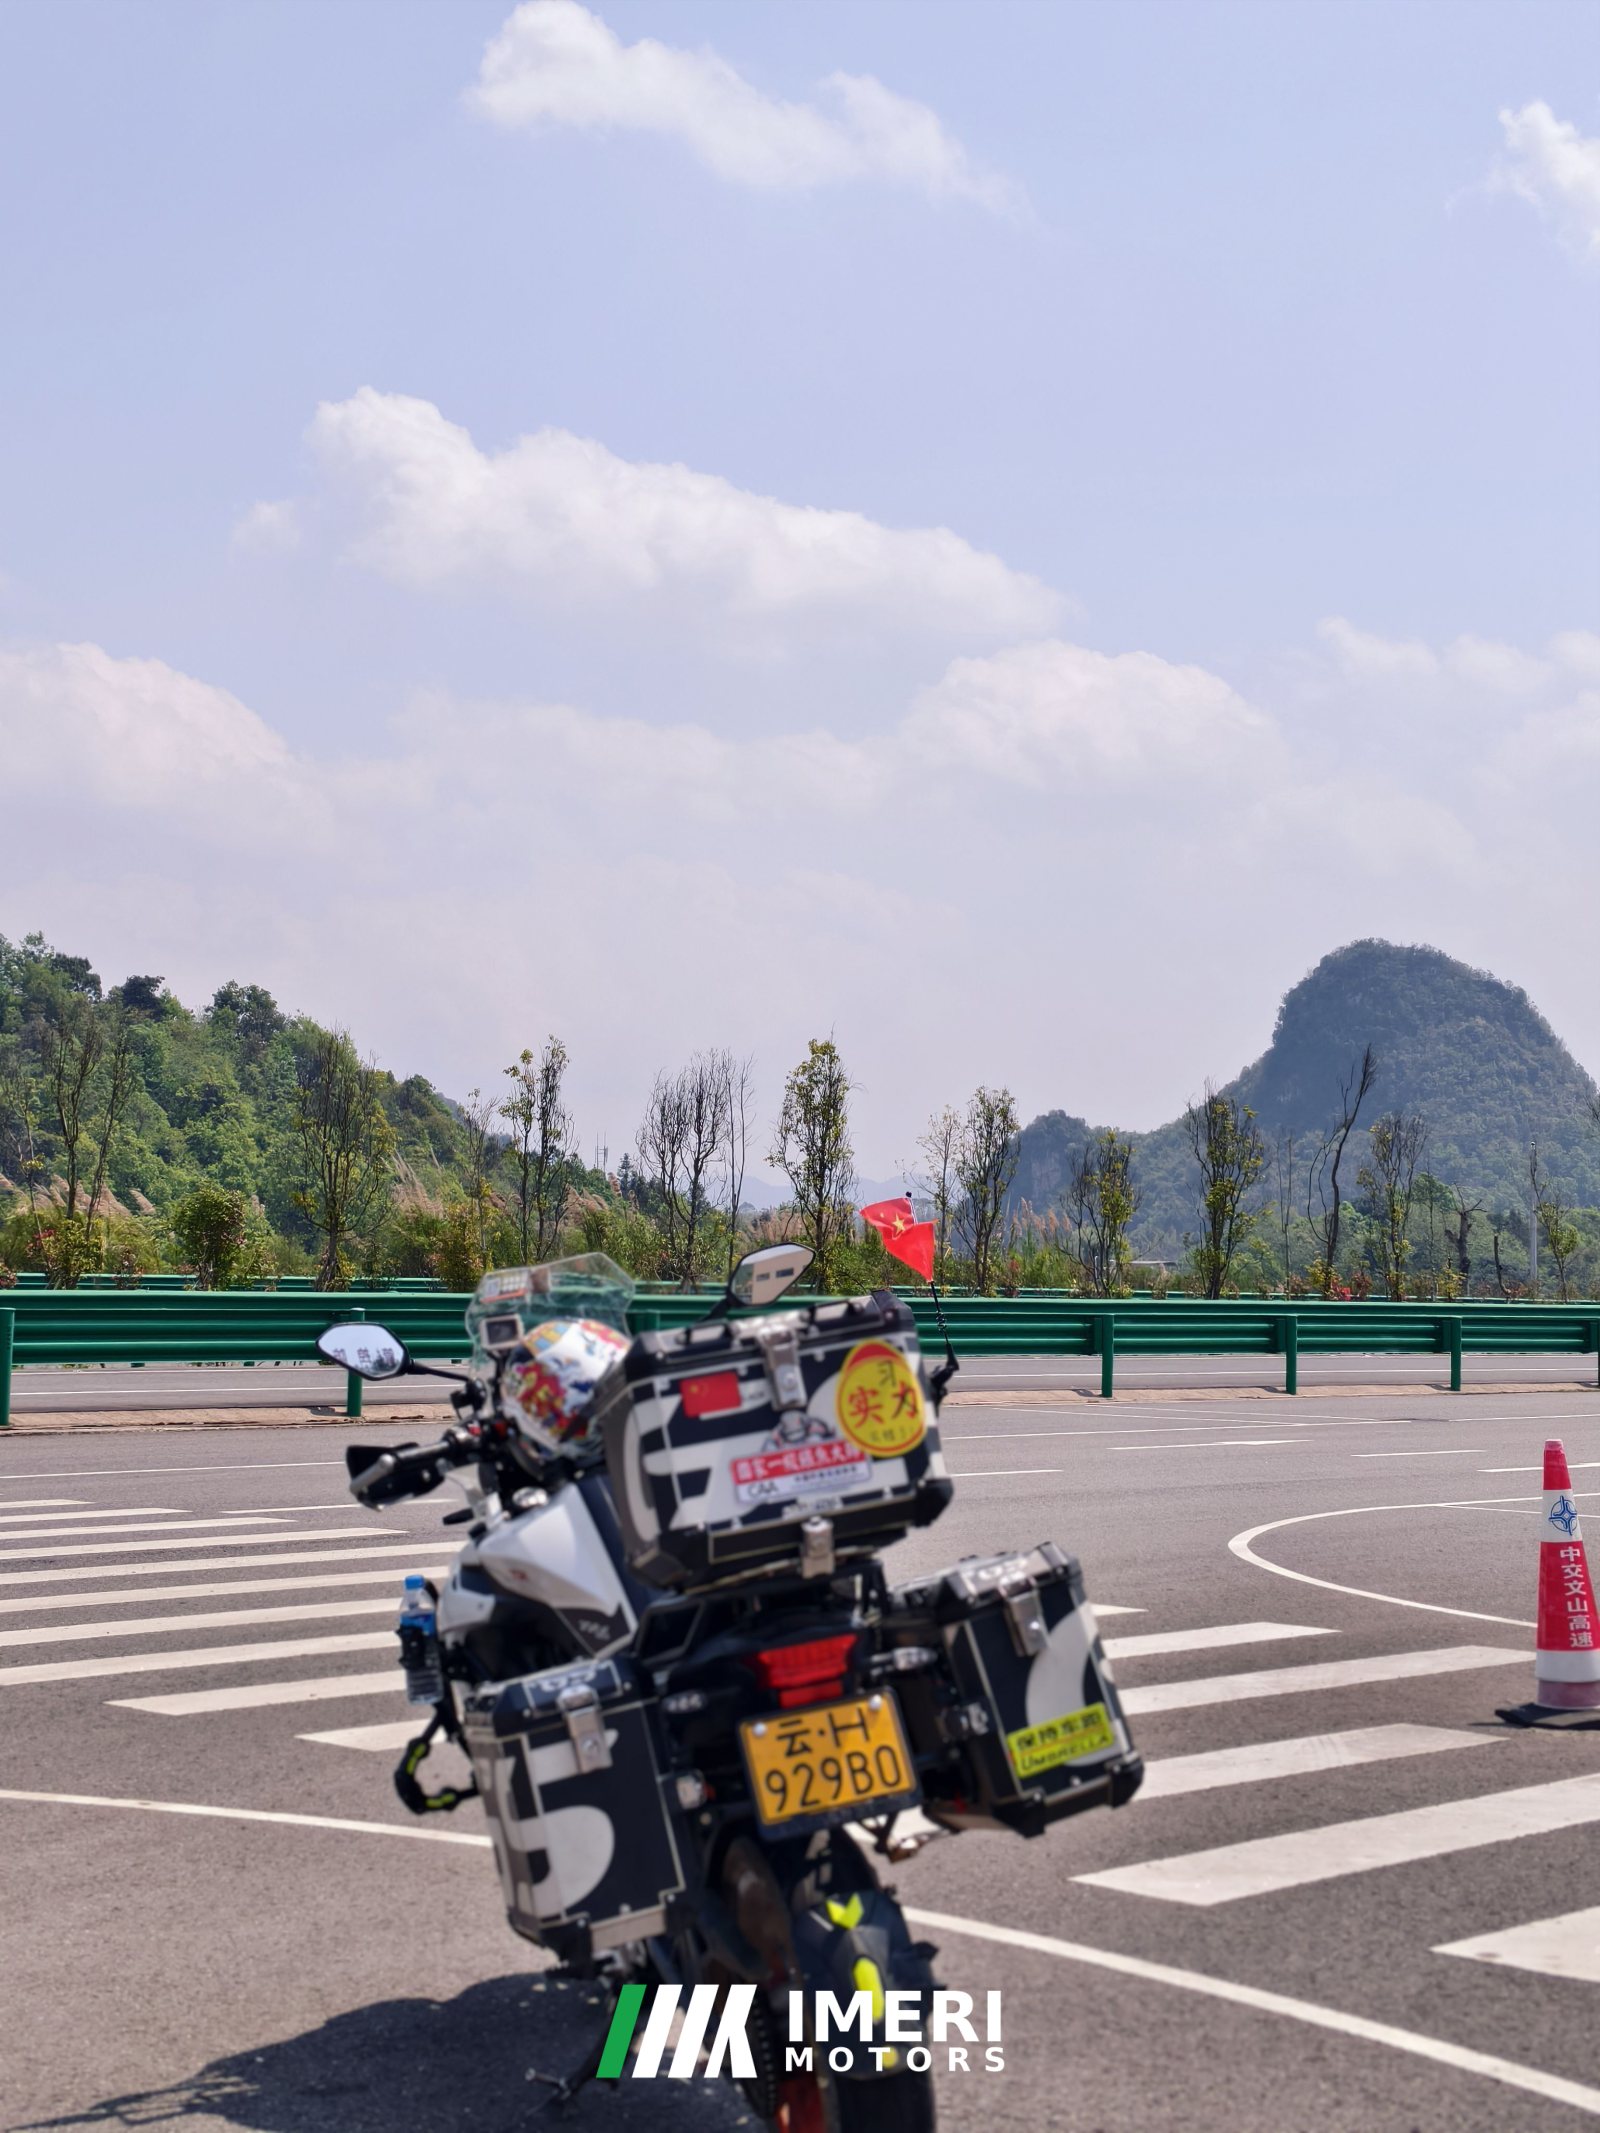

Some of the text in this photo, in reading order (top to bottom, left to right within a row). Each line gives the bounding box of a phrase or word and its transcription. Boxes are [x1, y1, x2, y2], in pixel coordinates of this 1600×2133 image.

[1560, 1546, 1594, 1648] 中交文山高速
